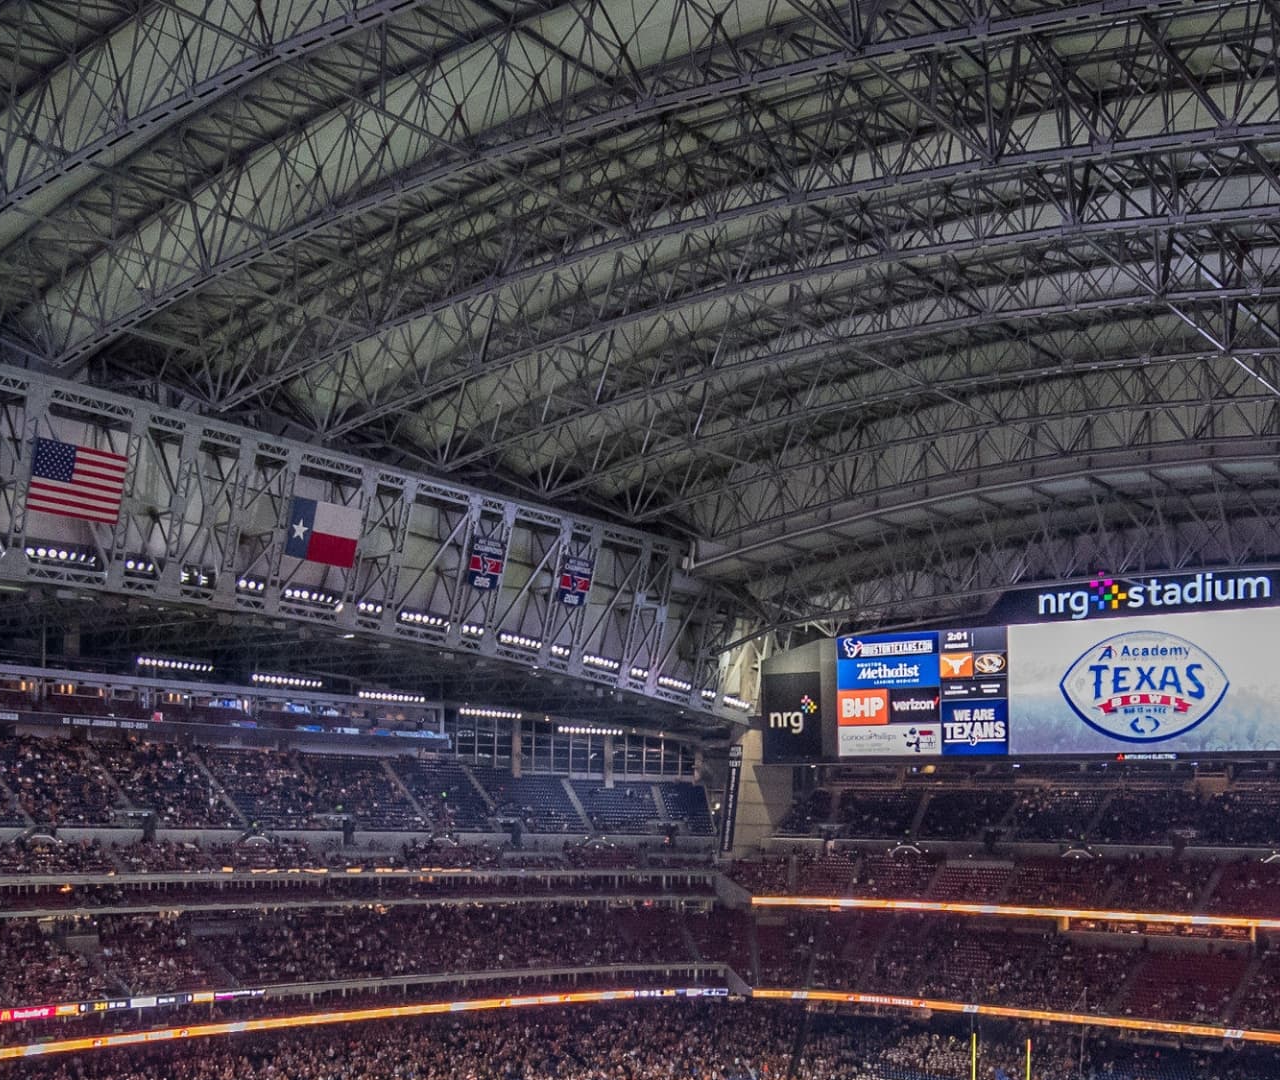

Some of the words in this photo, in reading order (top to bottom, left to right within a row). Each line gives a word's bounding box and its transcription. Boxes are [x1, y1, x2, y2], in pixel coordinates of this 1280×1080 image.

[1038, 590, 1089, 619] nrg
[1127, 573, 1271, 608] stadium
[947, 631, 968, 641] 2:01
[1120, 644, 1191, 659] Academy
[856, 663, 920, 680] Methodist
[1088, 663, 1206, 700] TEXAS
[842, 697, 884, 718] BHP
[892, 698, 935, 712] verizon
[1111, 694, 1178, 708] BOWL
[953, 709, 973, 721] WE
[975, 707, 995, 720] ARE
[769, 711, 804, 734] nrg
[943, 721, 1006, 740] TEXANS
[841, 732, 896, 742] ConocoPhillips
